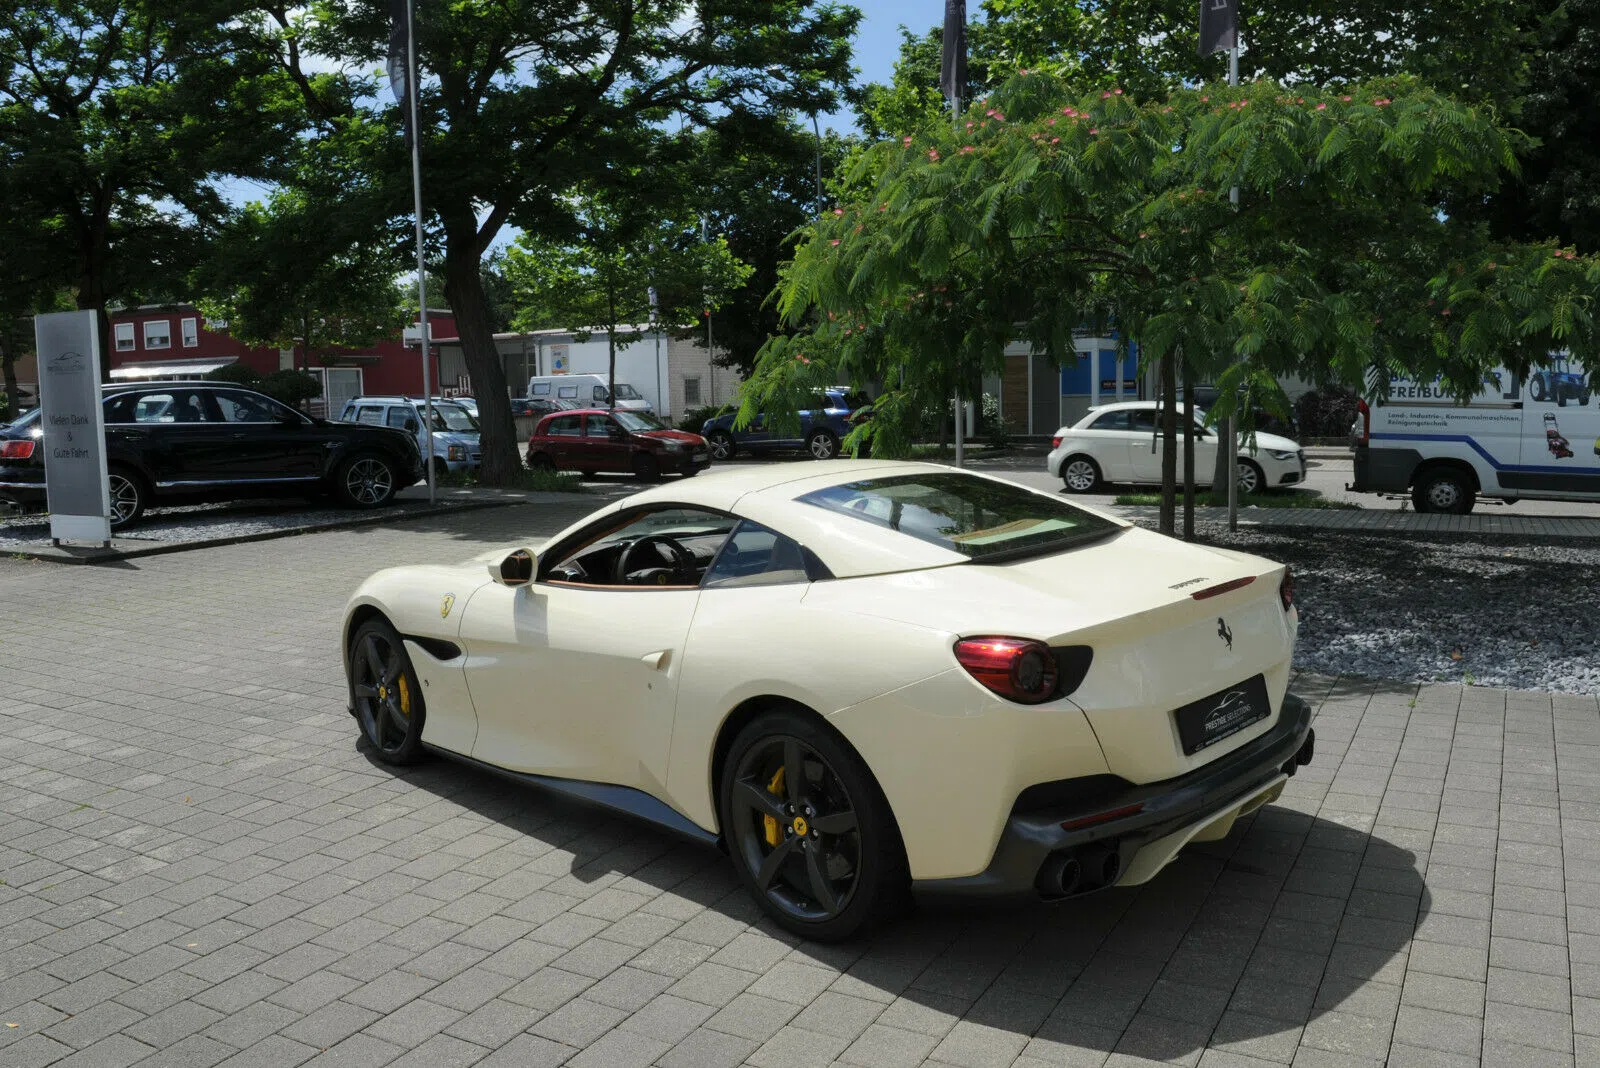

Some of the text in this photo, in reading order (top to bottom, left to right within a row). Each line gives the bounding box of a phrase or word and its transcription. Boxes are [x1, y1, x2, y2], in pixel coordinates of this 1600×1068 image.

[49, 414, 89, 425] Vielen Dank
[67, 431, 73, 442] &
[53, 447, 89, 459] Gute Fahrt
[1205, 714, 1227, 731] PRESTIGE
[1226, 703, 1252, 720] SELECTIONS
